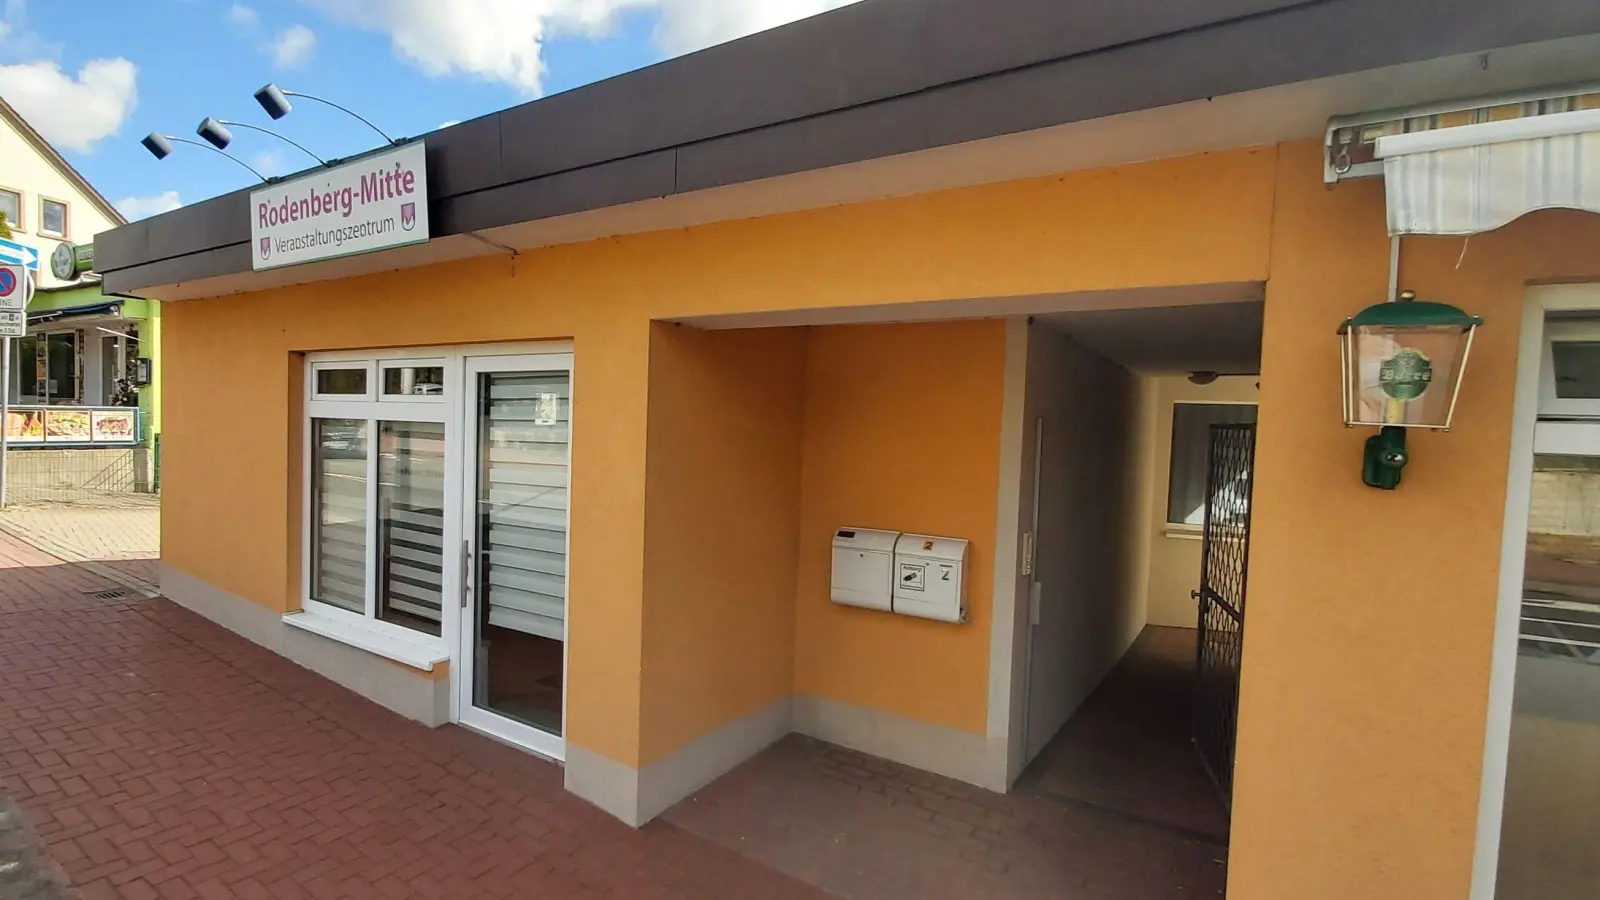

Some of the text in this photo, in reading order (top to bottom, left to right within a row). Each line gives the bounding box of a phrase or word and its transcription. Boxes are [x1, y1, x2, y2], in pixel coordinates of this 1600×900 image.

[259, 167, 415, 229] Rodenberg-Mitte
[274, 217, 395, 253] Veranstaltungszentrum
[923, 541, 933, 551] 2
